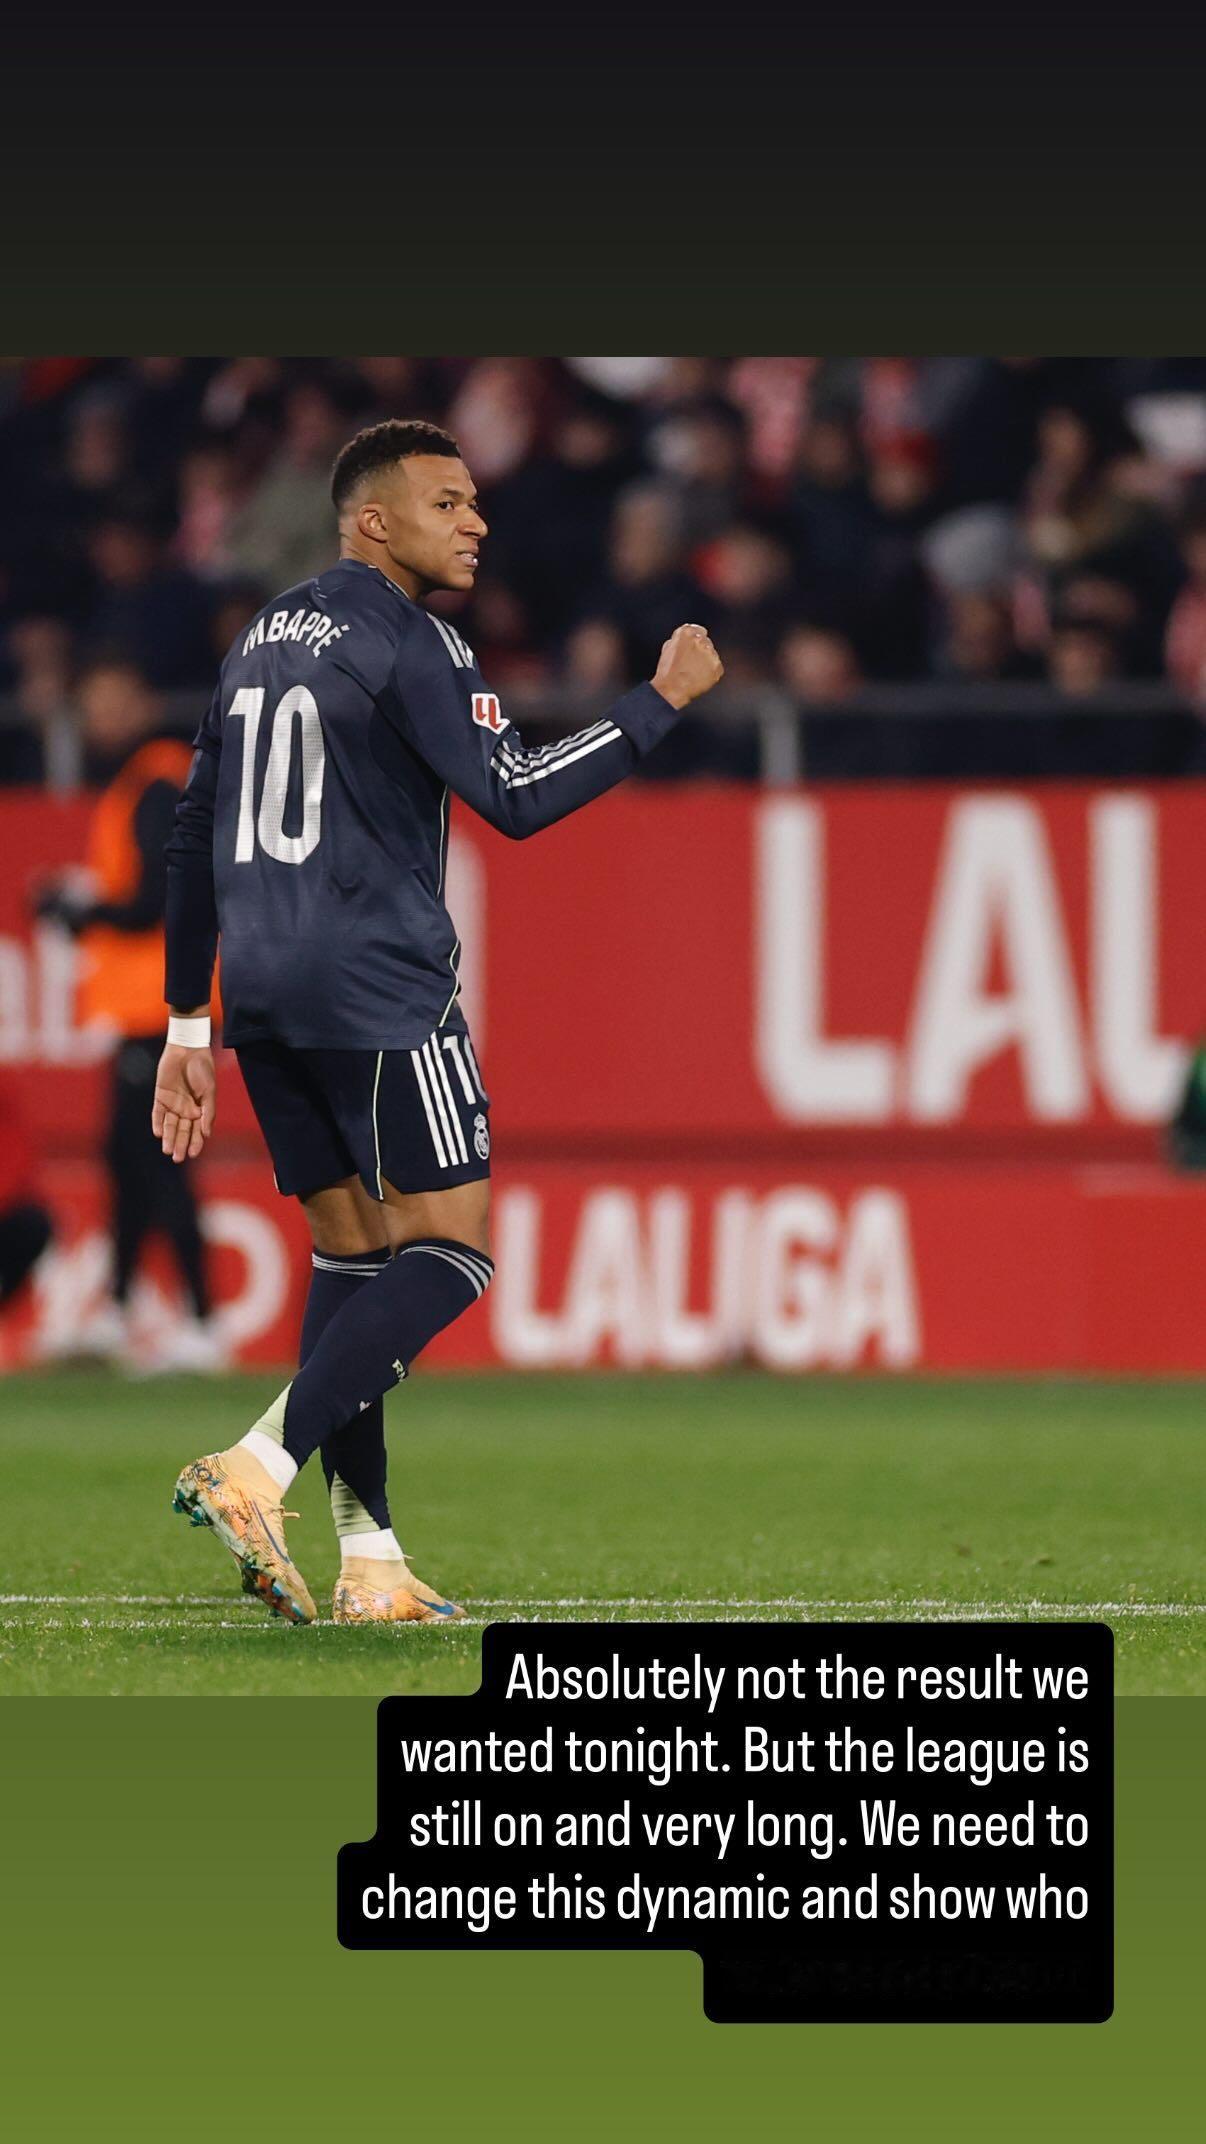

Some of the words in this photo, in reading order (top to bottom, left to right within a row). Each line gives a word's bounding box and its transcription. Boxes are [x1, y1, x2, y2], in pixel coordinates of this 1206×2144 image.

[242, 609, 350, 658] MBAPPÉ
[226, 685, 325, 865] 10
[491, 1186, 918, 1367] LALIGA
